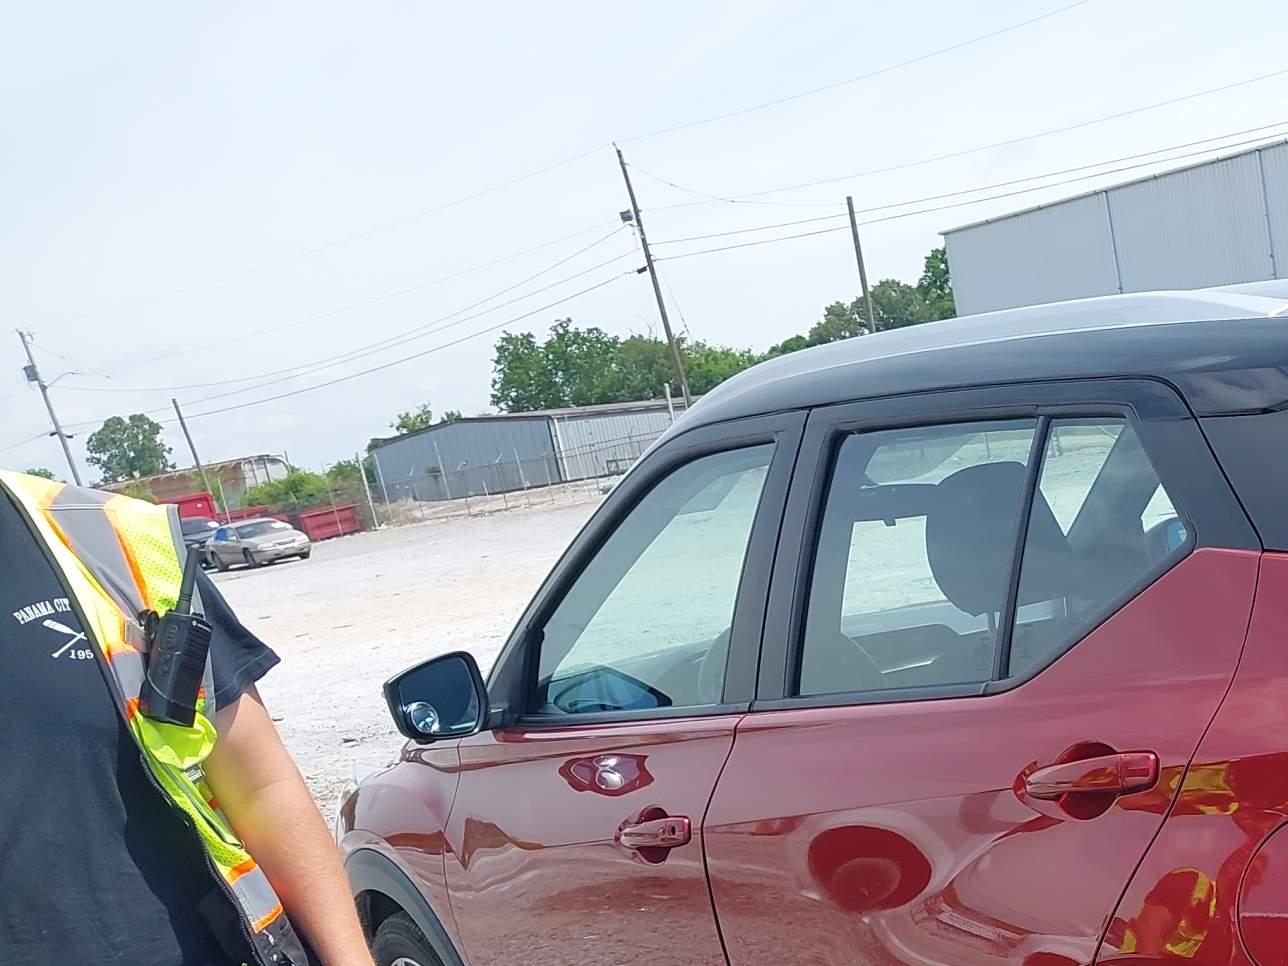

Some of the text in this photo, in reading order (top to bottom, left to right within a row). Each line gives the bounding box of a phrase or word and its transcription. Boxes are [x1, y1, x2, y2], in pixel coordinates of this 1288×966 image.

[13, 598, 71, 625] PANAMA CIT
[69, 649, 94, 660] 195
